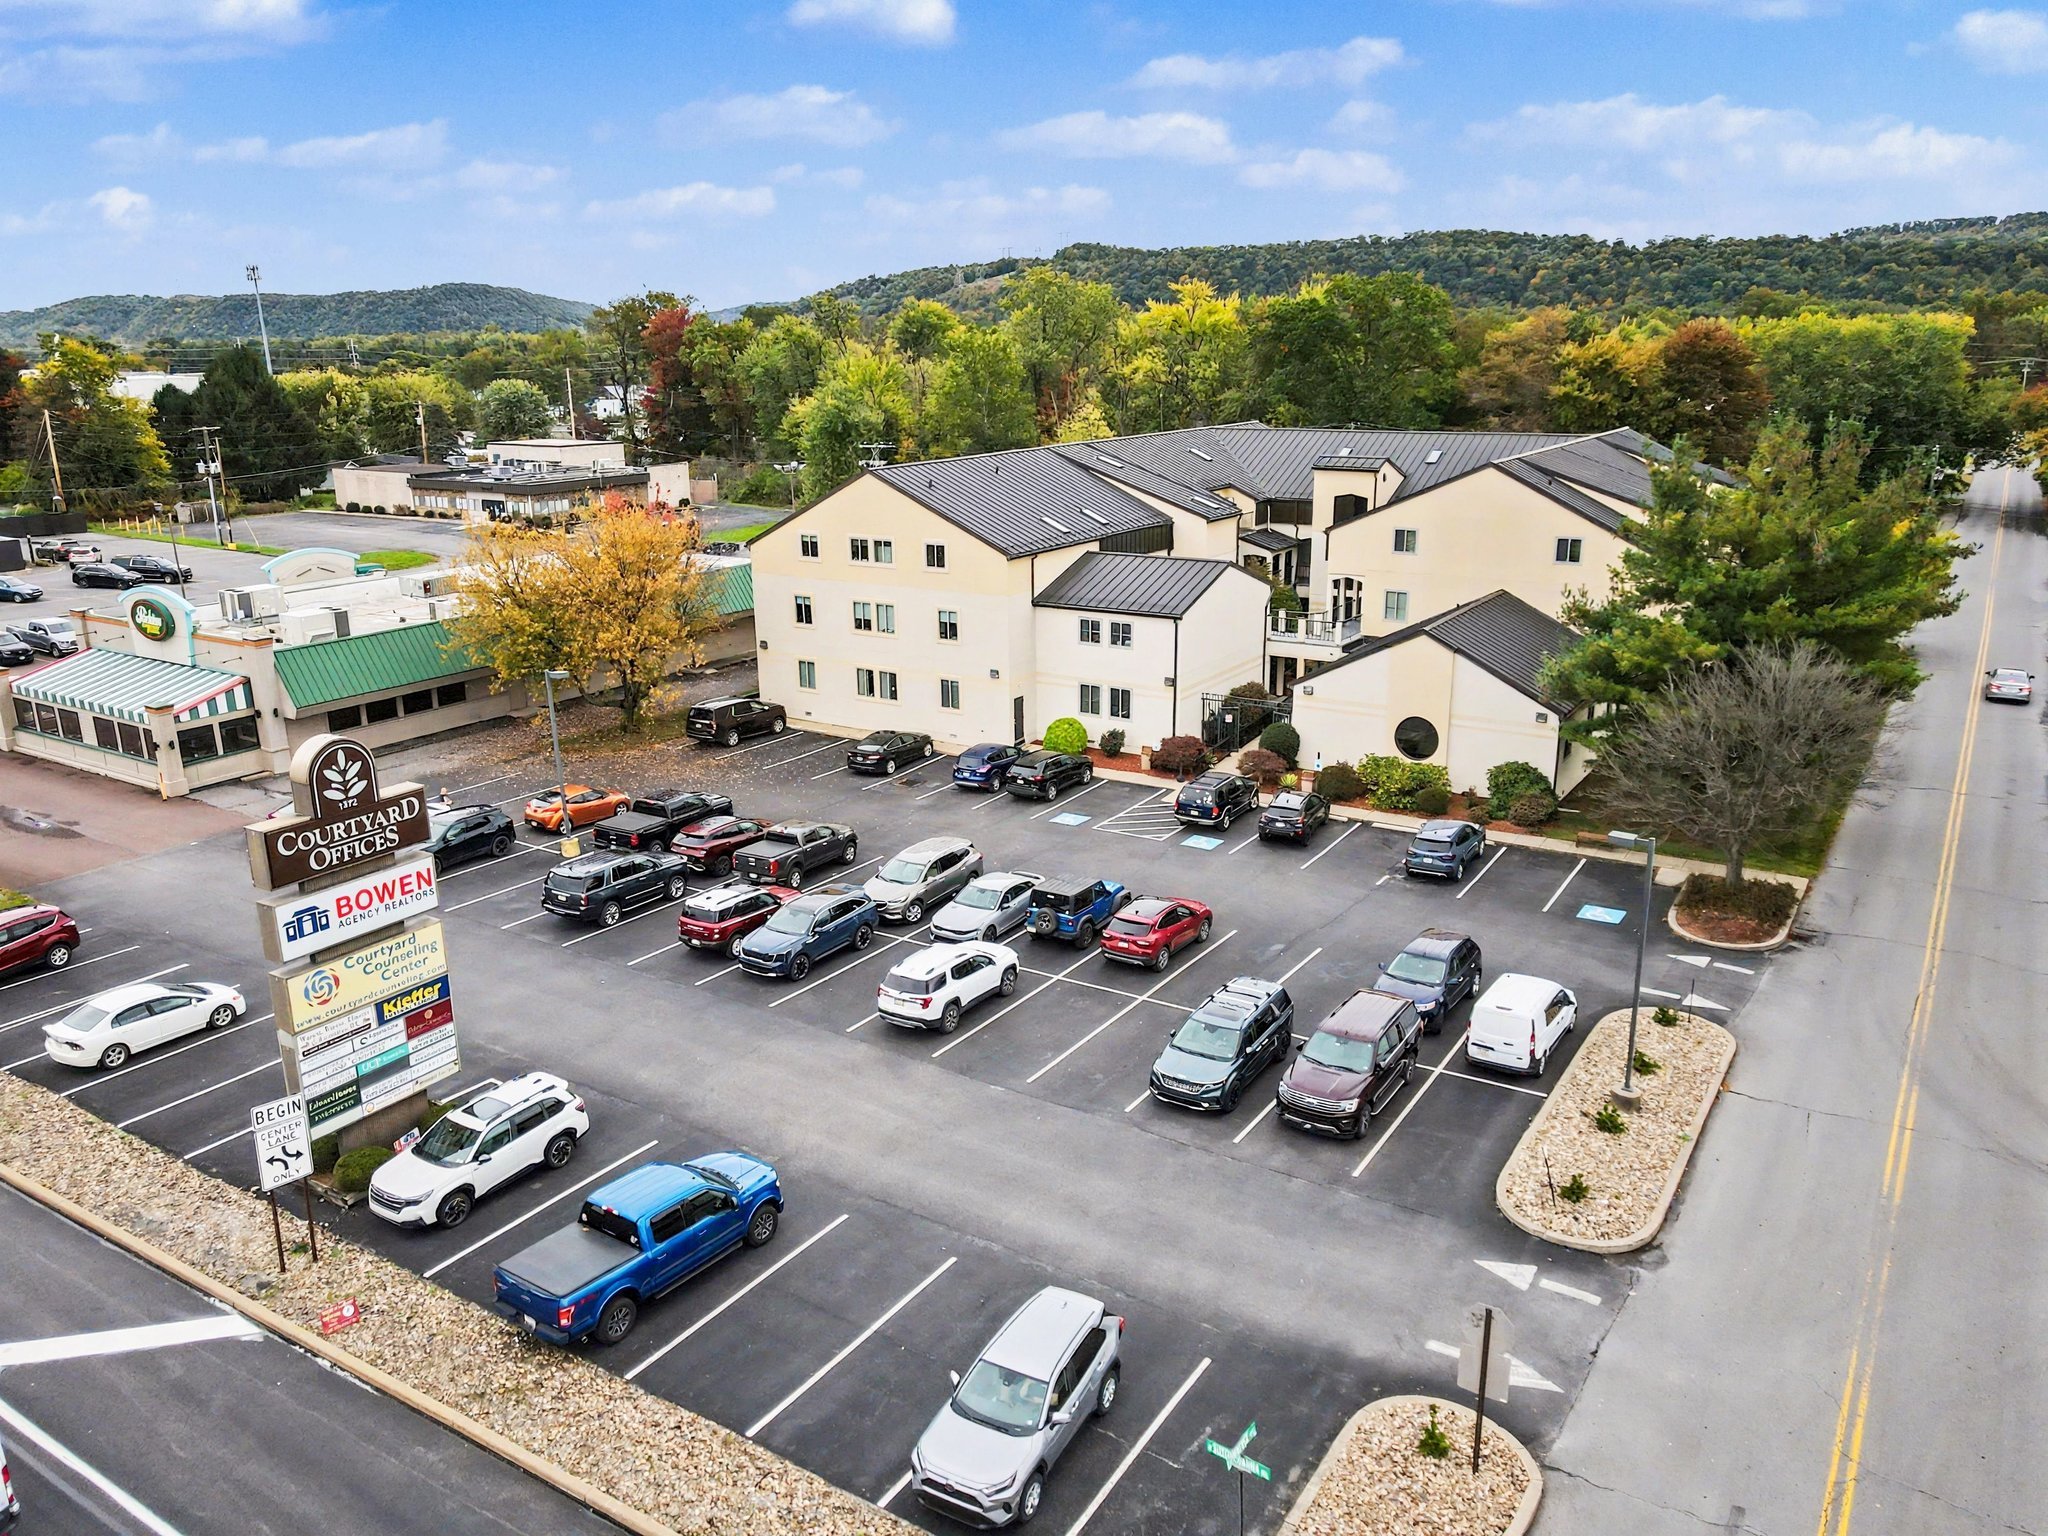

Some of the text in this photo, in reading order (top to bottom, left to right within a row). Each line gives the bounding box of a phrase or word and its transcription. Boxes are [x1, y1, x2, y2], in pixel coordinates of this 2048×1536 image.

[276, 796, 420, 856] COURTYARD
[309, 825, 399, 871] OFFICES
[335, 867, 433, 918] BOWEN
[338, 887, 435, 928] AGENCY REALTORS
[344, 932, 416, 969] Courtyard
[362, 940, 439, 975] Counseling
[381, 956, 428, 981] Center
[383, 982, 441, 1014] Kieffer
[255, 1098, 302, 1126] BEGIN
[260, 1121, 302, 1141] CENTER
[273, 1167, 302, 1183] ONLY
